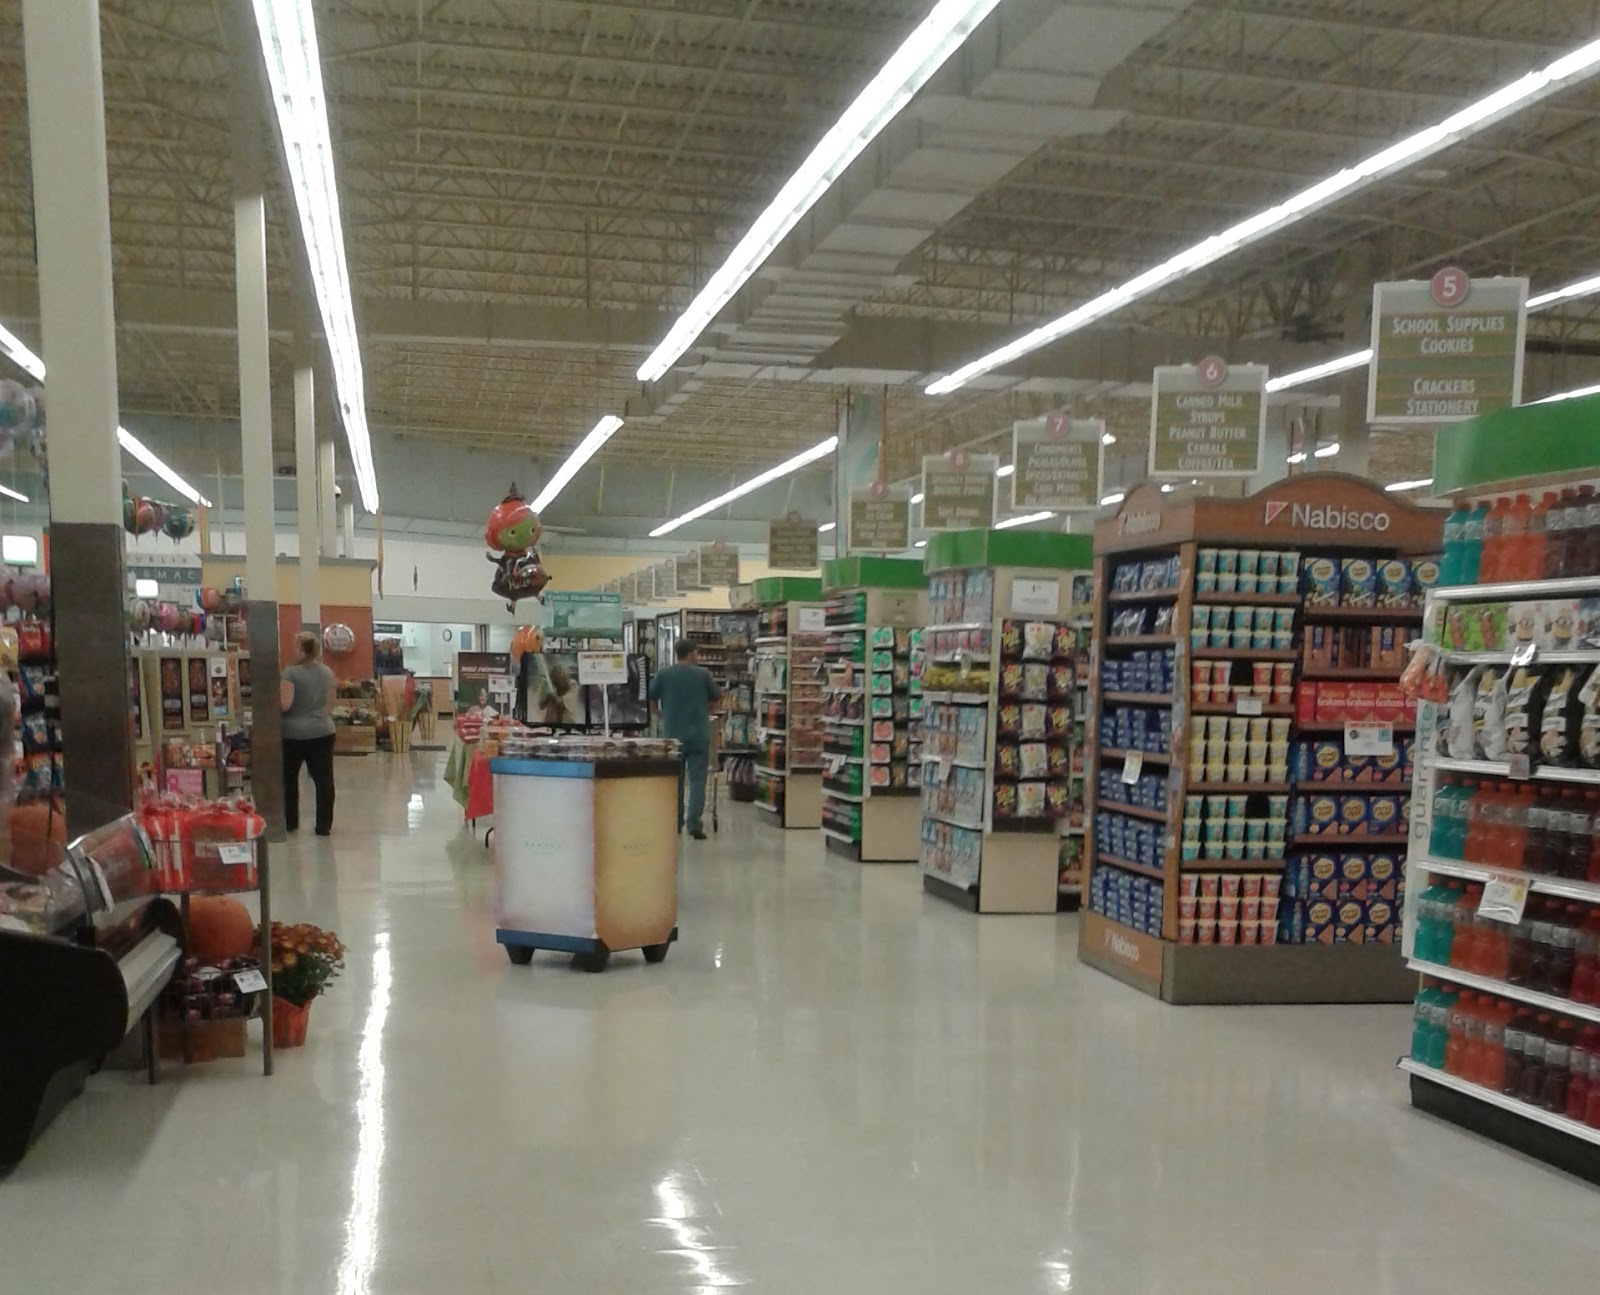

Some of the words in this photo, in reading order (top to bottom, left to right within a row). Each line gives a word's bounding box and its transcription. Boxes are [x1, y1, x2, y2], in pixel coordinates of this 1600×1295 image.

[1443, 276, 1456, 297] 5
[1392, 318, 1440, 334] SCHOOL
[1447, 316, 1505, 332] SUPPLIES
[1421, 337, 1474, 354] COOKIES
[1206, 362, 1217, 380] 6
[1413, 378, 1475, 395] CRACKERS
[1406, 398, 1479, 415] STATIONERY
[1055, 418, 1063, 432] 7
[1169, 427, 1206, 440] PEANUT
[1209, 426, 1247, 439] BUTTER
[1292, 503, 1390, 531] Nabisco
